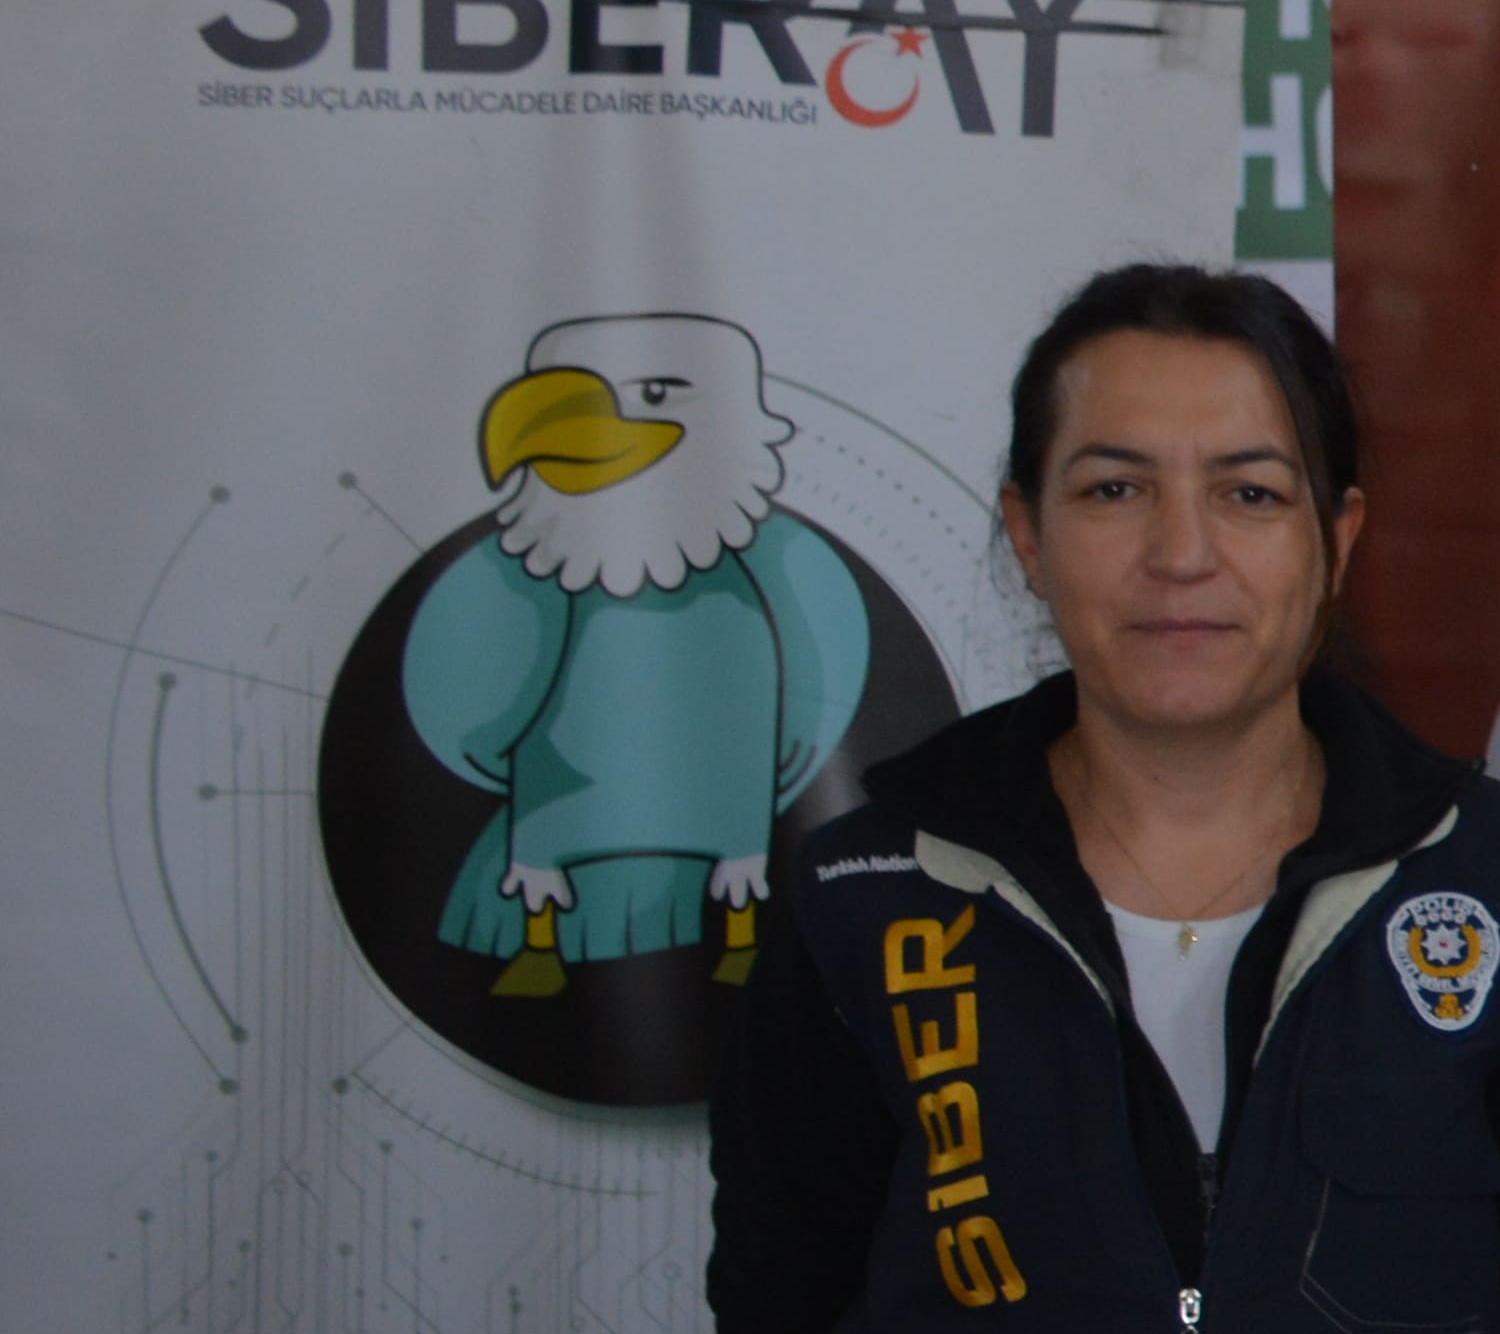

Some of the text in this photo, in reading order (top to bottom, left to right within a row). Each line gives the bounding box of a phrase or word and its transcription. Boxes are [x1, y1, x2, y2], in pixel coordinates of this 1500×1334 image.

[280, 83, 428, 115] SUÇLARLA
[434, 84, 578, 116] MÜCADELE
[582, 85, 656, 117] DAİRE
[659, 88, 820, 126] BAŞKANLIĞI
